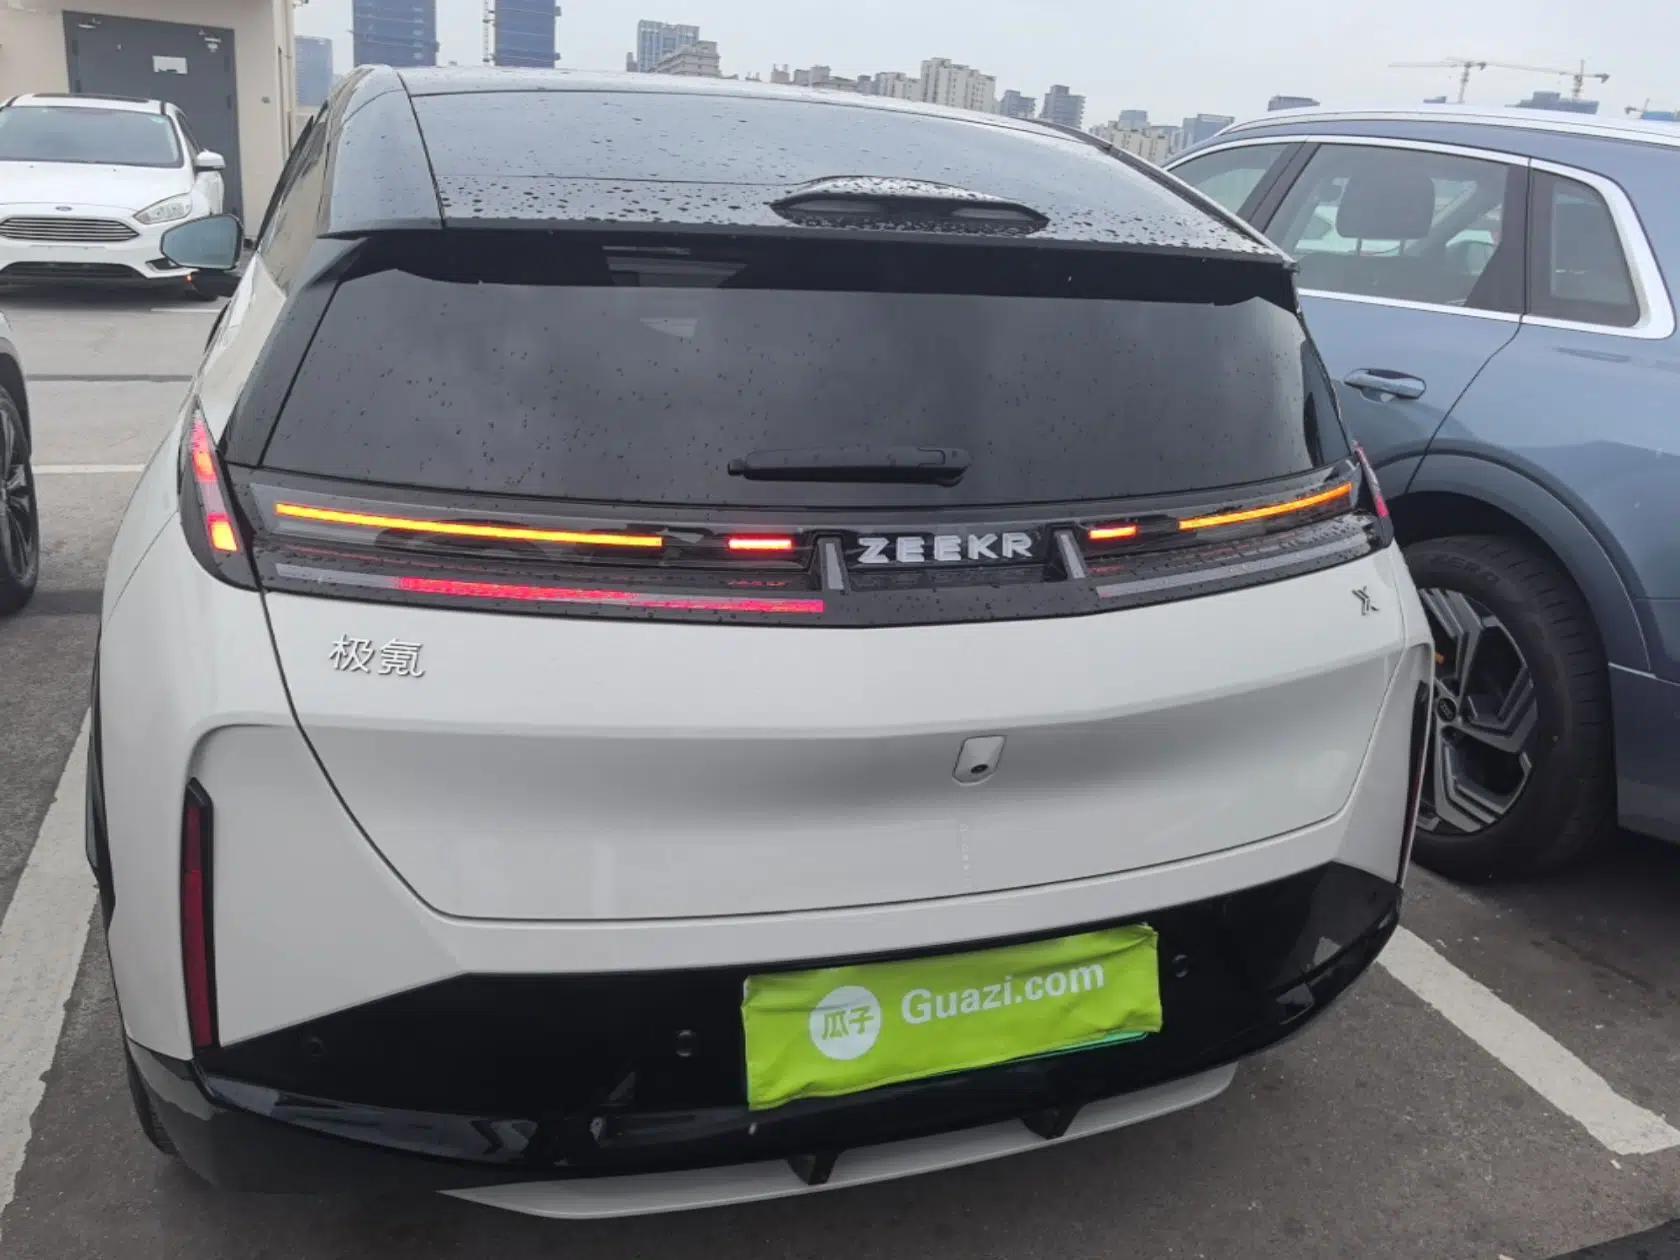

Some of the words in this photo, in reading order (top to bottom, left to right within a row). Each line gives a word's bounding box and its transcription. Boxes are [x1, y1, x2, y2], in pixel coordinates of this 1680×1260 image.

[857, 532, 1033, 563] ZEEKR
[328, 633, 426, 678] 极氪
[902, 963, 1104, 1024] Guazi.com
[821, 1005, 875, 1041] 瓜子
